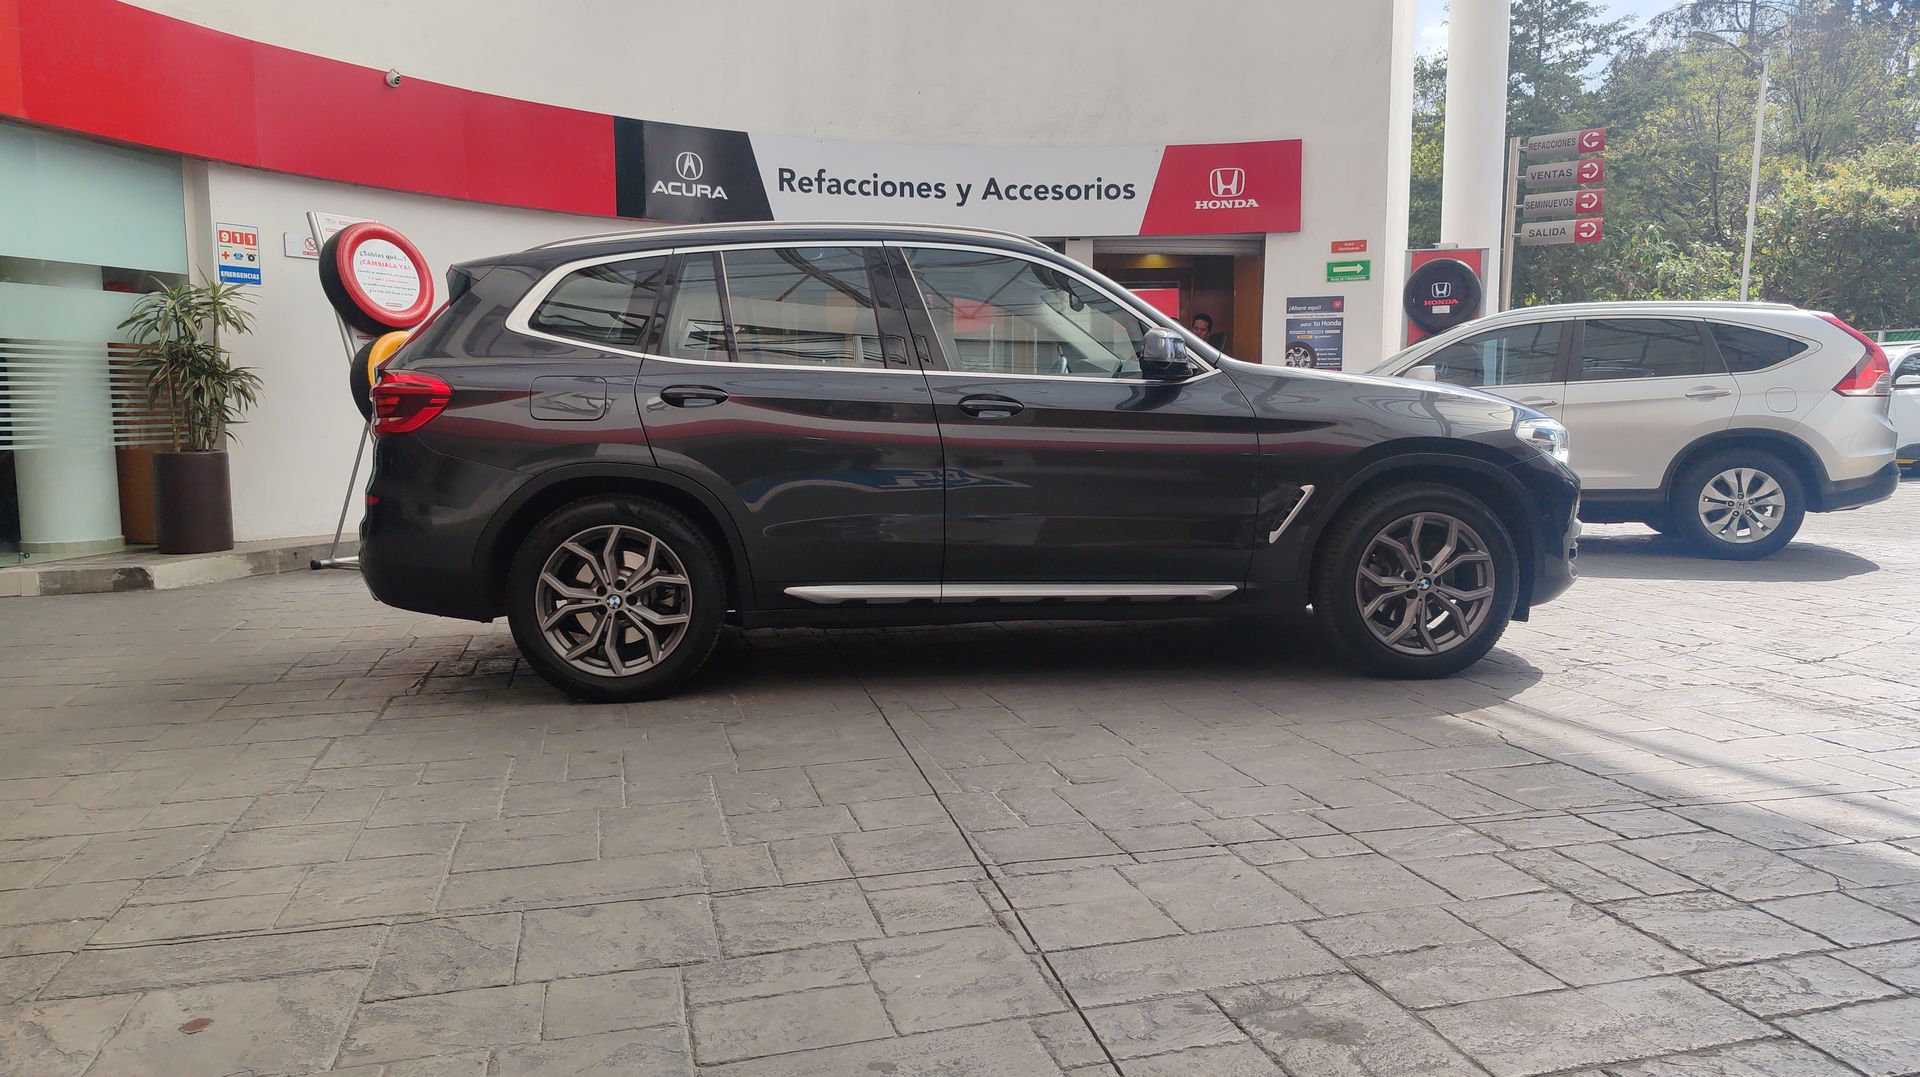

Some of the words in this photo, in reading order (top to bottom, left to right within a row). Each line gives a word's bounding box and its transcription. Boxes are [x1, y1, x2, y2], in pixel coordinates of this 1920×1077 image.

[1528, 138, 1576, 151] REFACCIONES
[1530, 169, 1573, 180] VENTAS
[652, 180, 728, 200] ACURA
[778, 167, 947, 199] Refacciones
[956, 181, 973, 207] y
[982, 177, 1136, 201] Accesorios
[1194, 198, 1260, 210] HONDA
[1525, 198, 1574, 210] SEMINUEVOS
[1528, 227, 1567, 238] SALIDA
[221, 270, 260, 280] EMERGENCIAS
[1321, 319, 1342, 327] Honda
